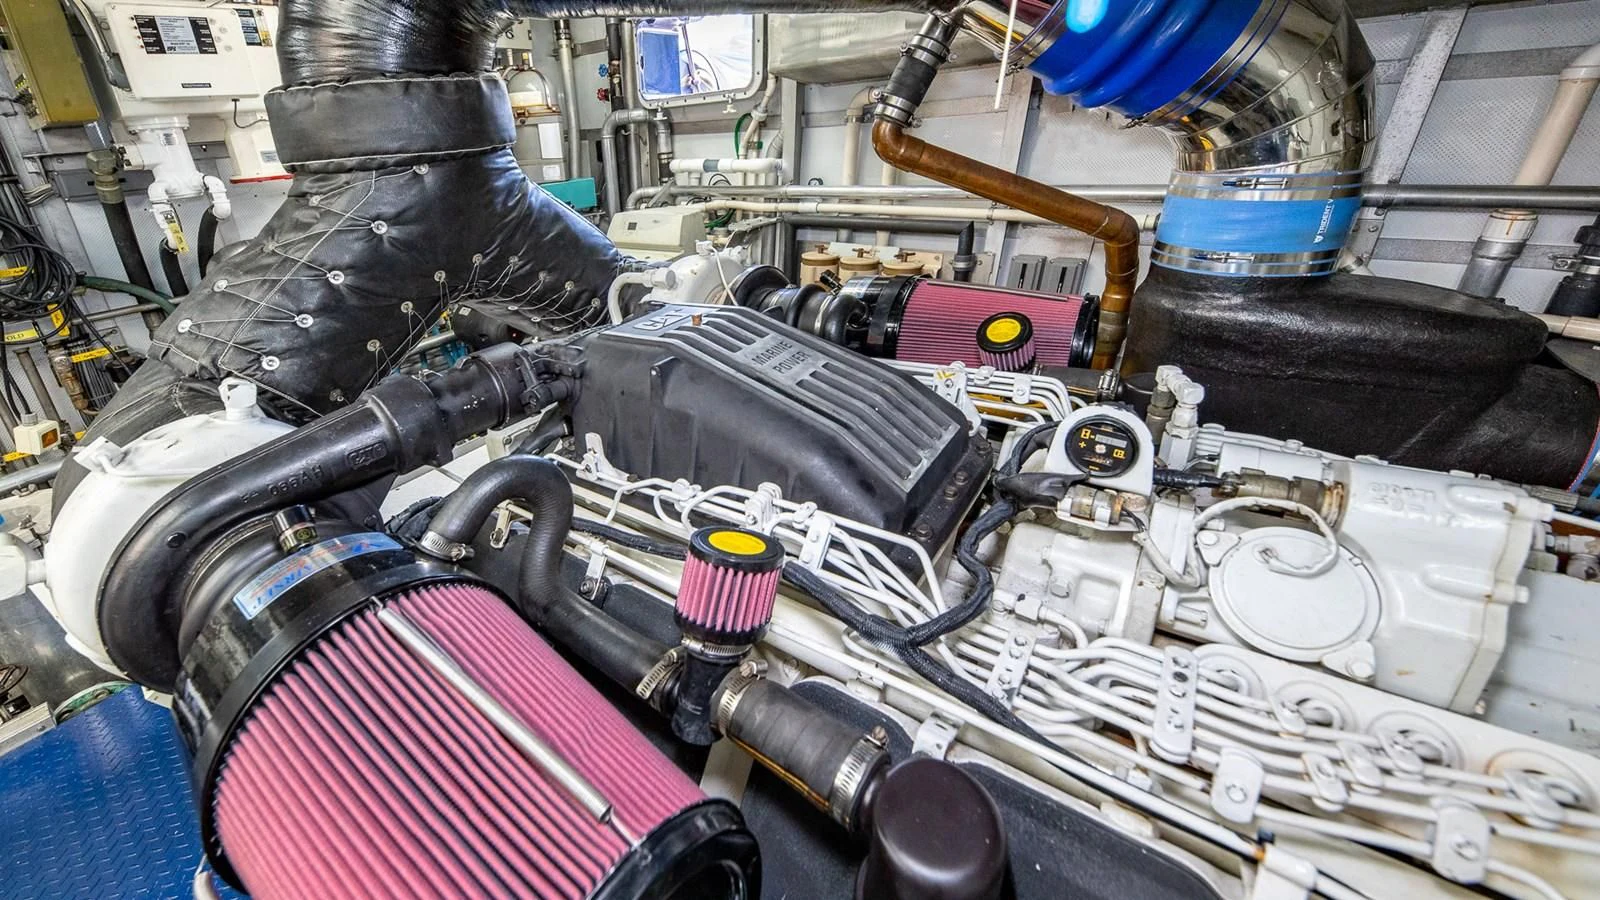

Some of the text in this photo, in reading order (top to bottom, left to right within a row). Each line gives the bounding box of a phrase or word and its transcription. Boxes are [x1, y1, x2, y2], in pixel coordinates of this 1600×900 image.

[1316, 204, 1332, 234] TRIDENT
[751, 340, 793, 366] MARINE
[772, 351, 811, 375] POWER
